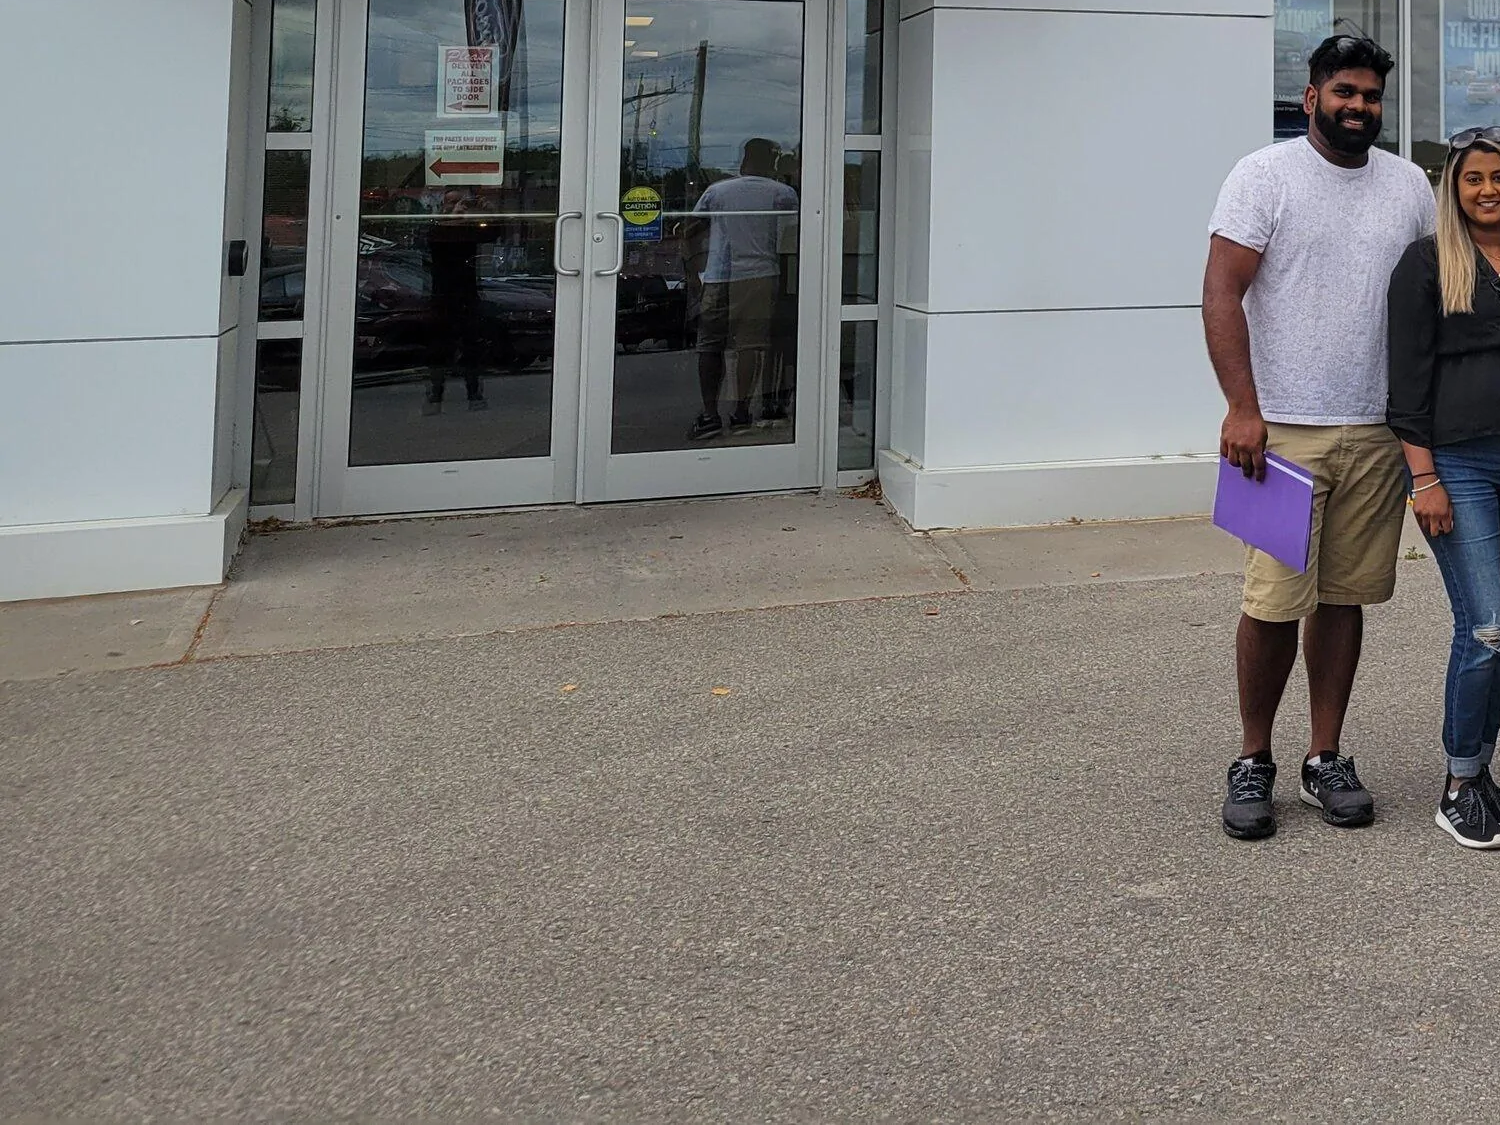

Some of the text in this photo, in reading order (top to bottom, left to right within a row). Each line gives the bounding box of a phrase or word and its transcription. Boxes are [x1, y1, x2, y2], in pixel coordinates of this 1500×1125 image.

[1275, 8, 1325, 33] ATIONS
[1447, 21, 1479, 48] THE
[451, 62, 486, 70] DELIVER
[460, 70, 477, 78] ALL
[447, 78, 490, 86] PACKAGES
[456, 93, 480, 101] DOOR
